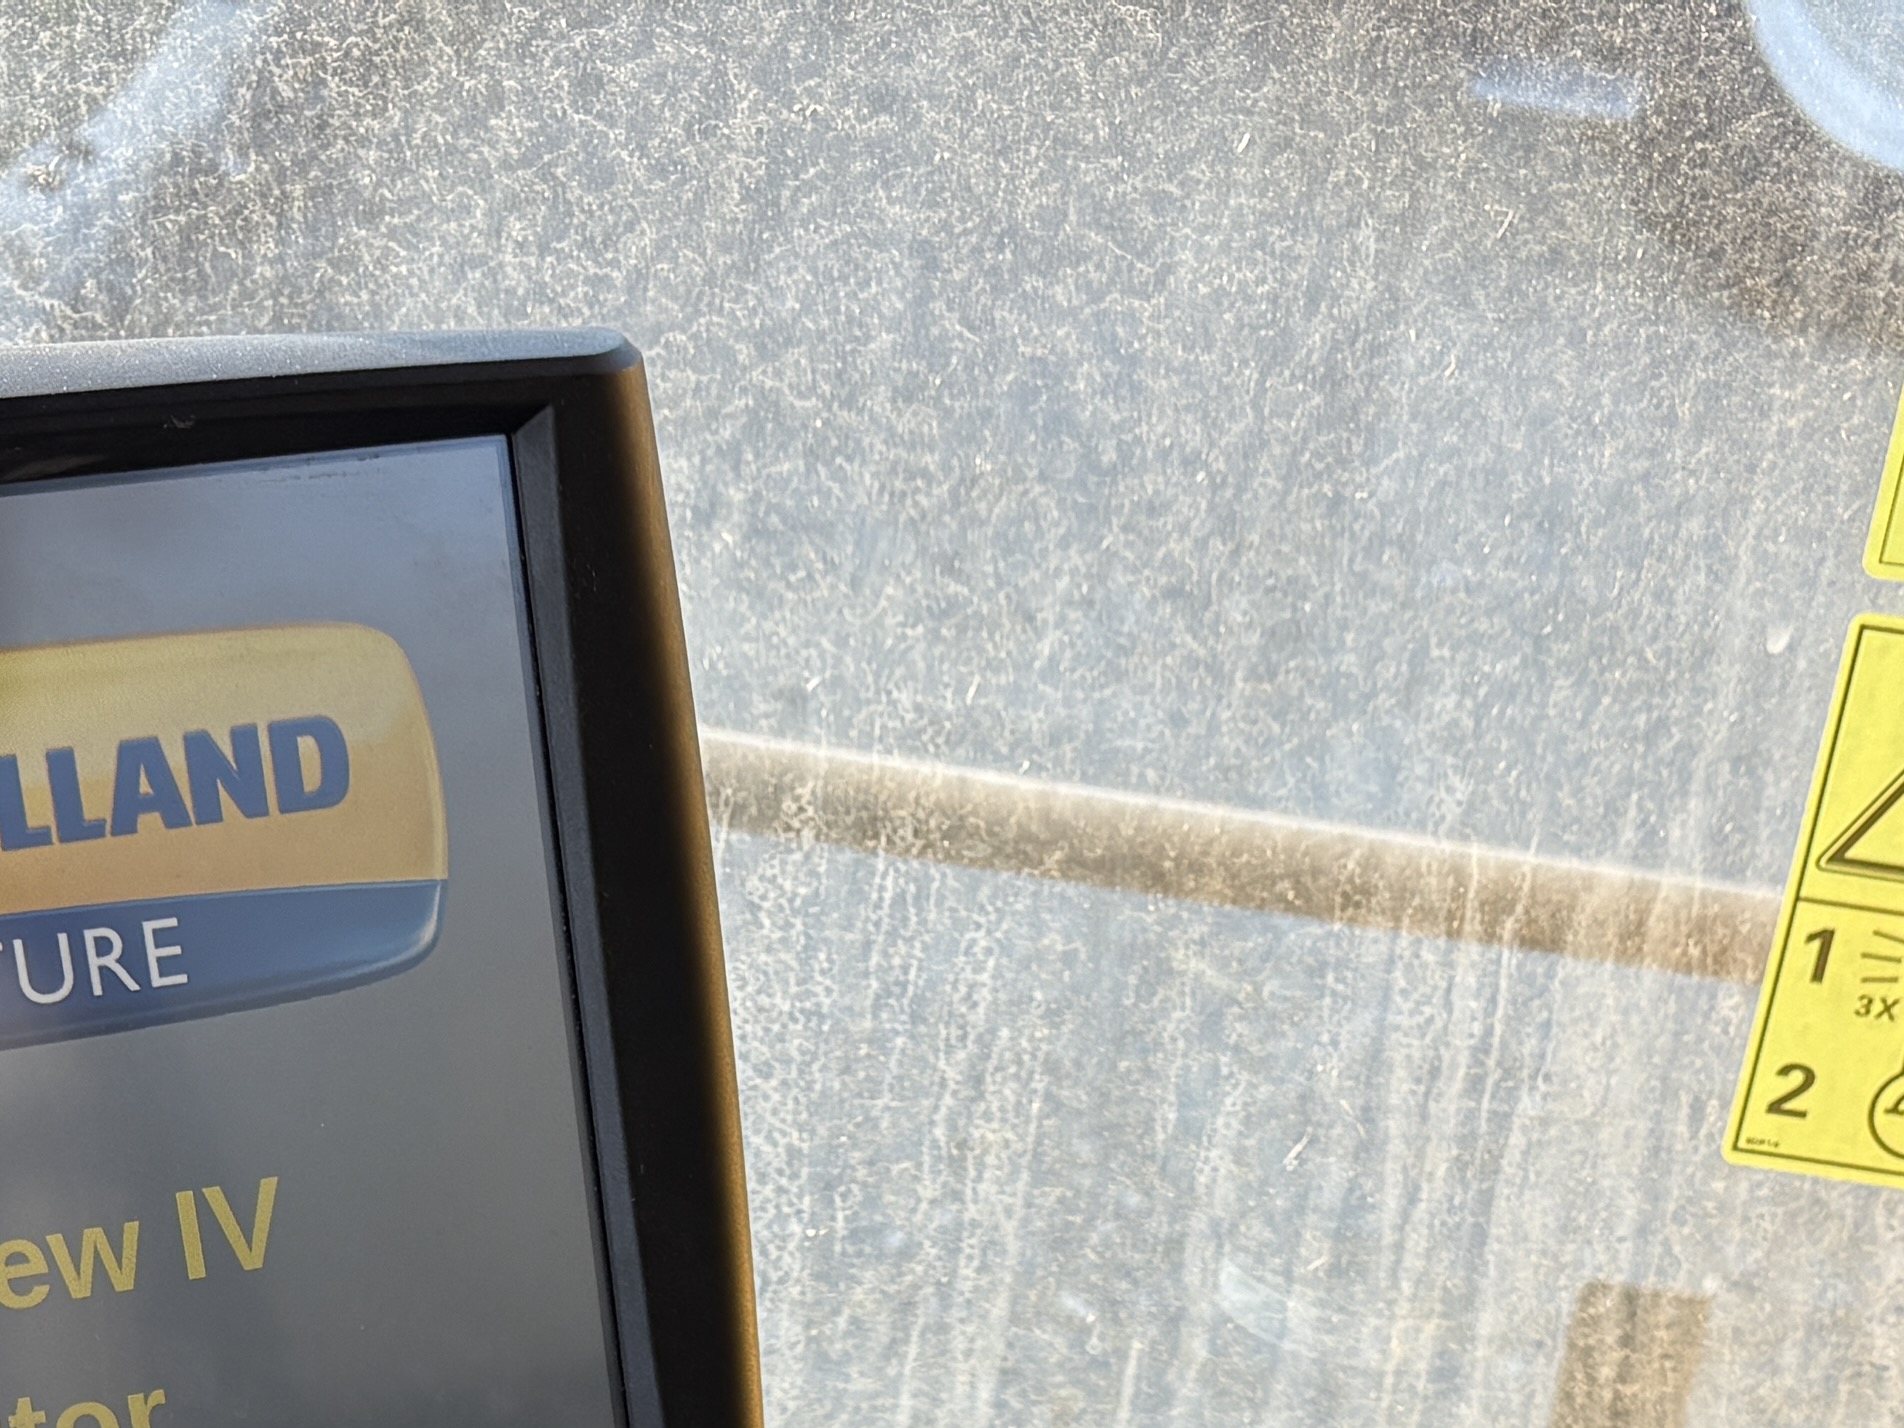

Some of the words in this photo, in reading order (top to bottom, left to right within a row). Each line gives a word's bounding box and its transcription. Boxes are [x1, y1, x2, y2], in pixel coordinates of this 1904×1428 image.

[1804, 927, 1835, 984] 1
[1854, 994, 1901, 1022] 3X
[1765, 1063, 1816, 1119] 2
[175, 1176, 278, 1280] IV
